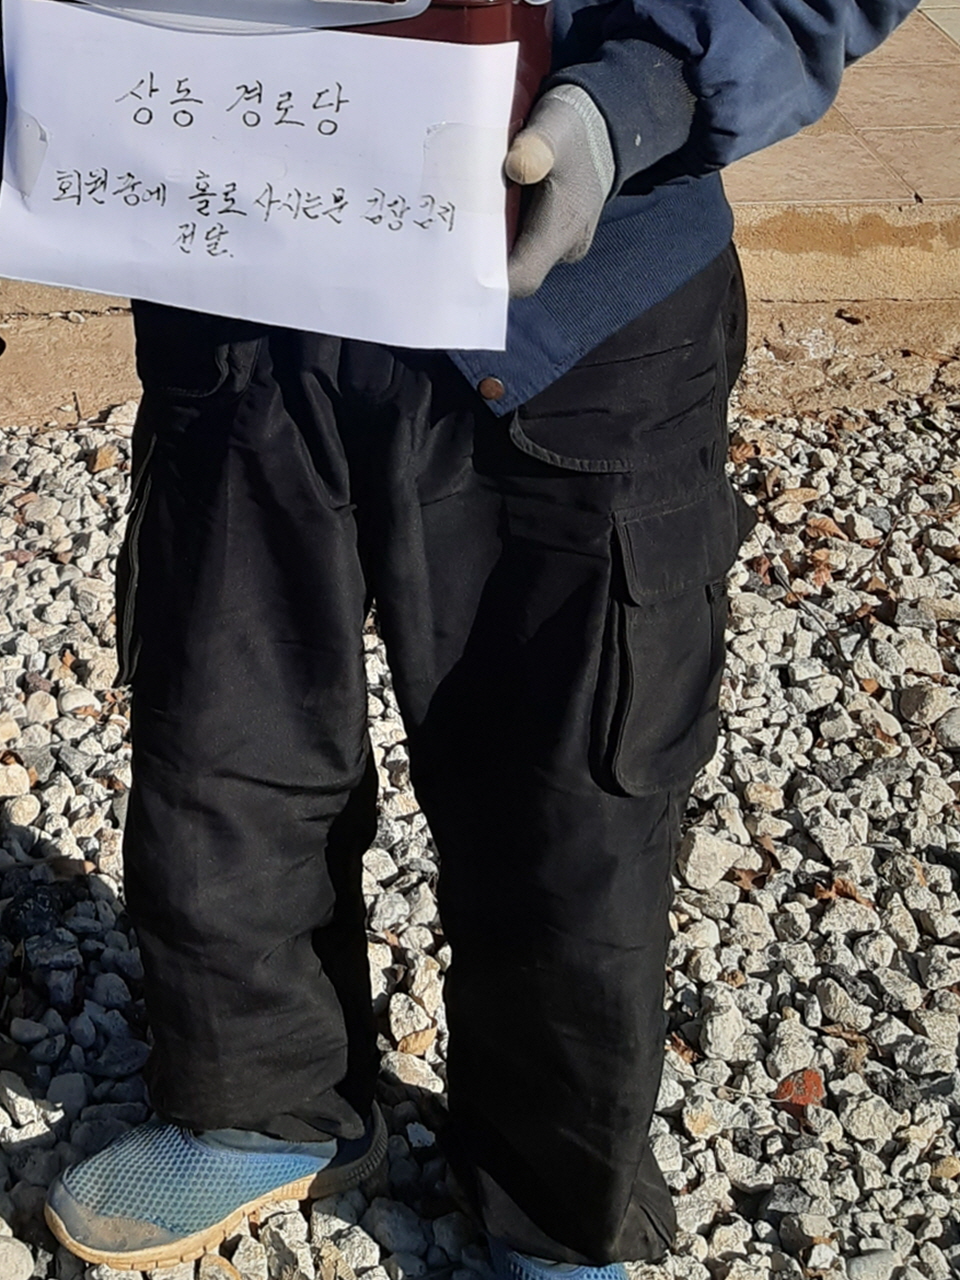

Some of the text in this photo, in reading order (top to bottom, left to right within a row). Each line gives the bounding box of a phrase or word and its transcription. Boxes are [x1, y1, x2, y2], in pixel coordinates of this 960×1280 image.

[115, 71, 350, 136] 상동 경로당
[188, 169, 248, 217] 홀로
